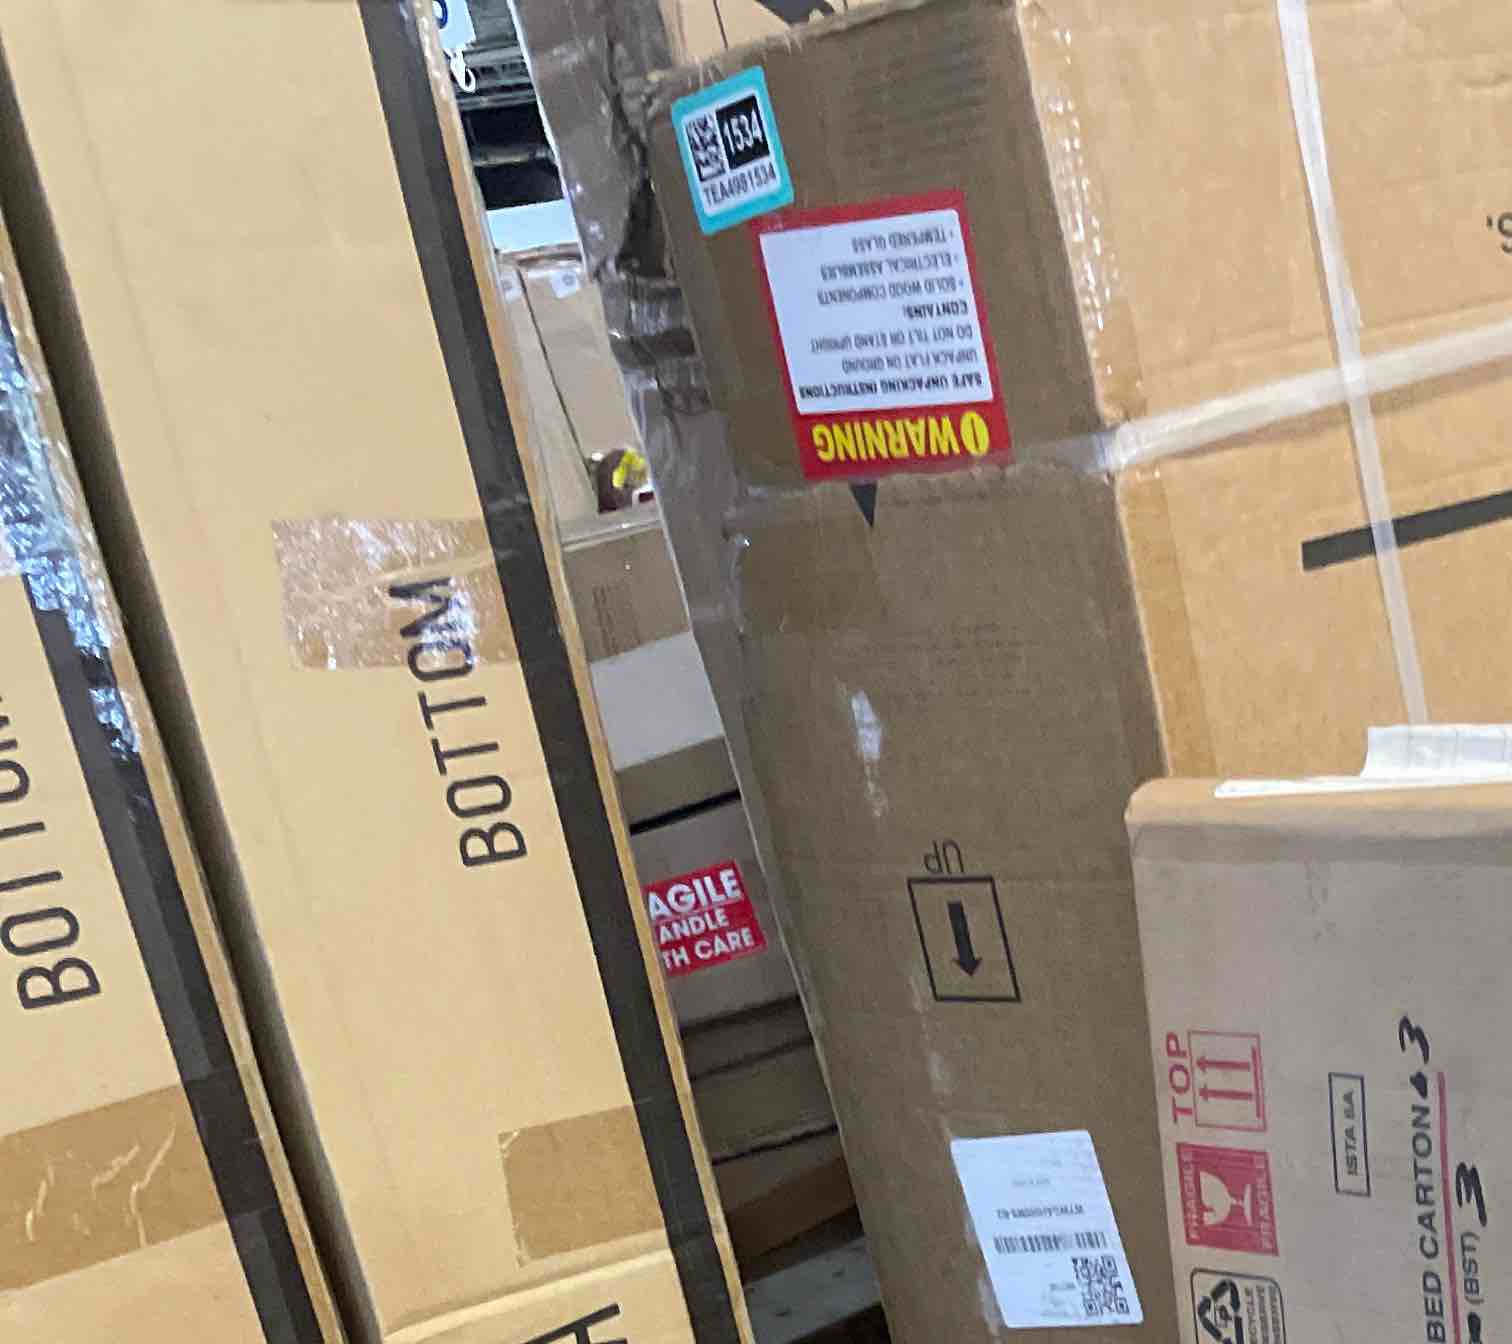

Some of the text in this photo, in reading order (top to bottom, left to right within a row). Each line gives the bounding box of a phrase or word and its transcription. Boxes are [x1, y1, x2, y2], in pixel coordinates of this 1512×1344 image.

[724, 110, 762, 156] 1534
[854, 332, 887, 347] STAND
[931, 326, 953, 341] NOT
[956, 324, 972, 339] DO
[903, 351, 929, 367] FLAT
[931, 348, 976, 365] UNPACK
[798, 371, 981, 399] SAFE UNPACKING INSTRUCTIONS
[811, 415, 960, 461] WARNING
[388, 576, 528, 867] BOTTOM
[924, 841, 964, 873] UP
[647, 868, 742, 921] AGILE
[658, 908, 729, 943] ANDLE
[695, 927, 755, 961] CARE
[1166, 1032, 1195, 1123] TOP
[1410, 1104, 1438, 1259] CARTON
[1461, 1231, 1486, 1305] (BST)
[1422, 1271, 1445, 1343] BED
